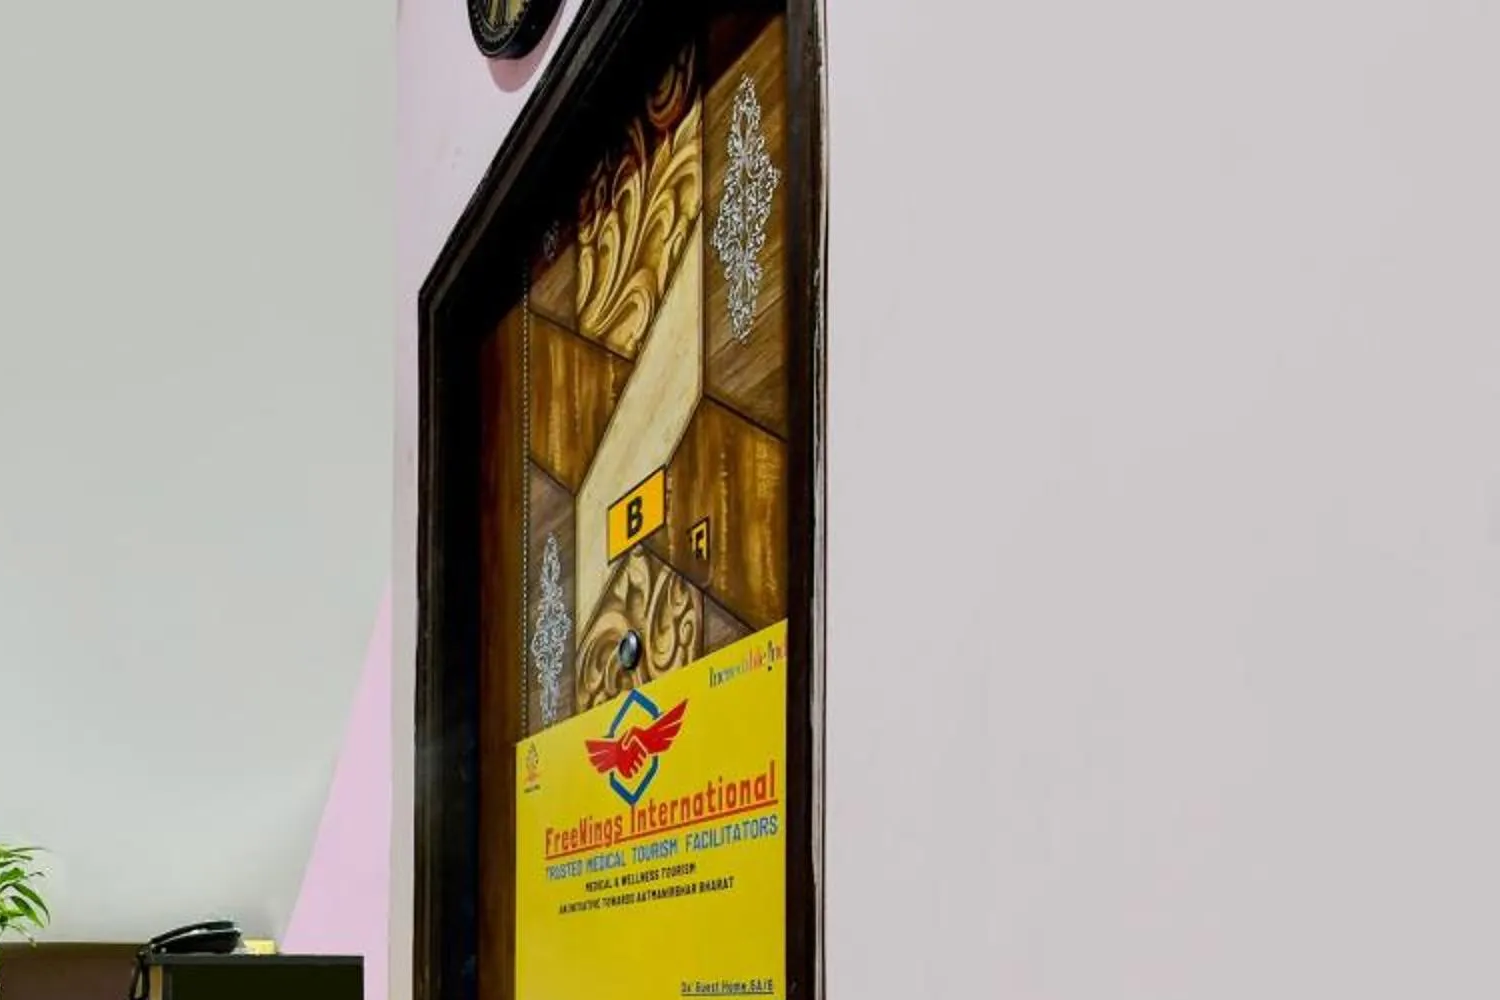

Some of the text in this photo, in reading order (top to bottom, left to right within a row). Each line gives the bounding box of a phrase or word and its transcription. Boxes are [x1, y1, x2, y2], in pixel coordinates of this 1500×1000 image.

[627, 496, 643, 540] B
[630, 760, 775, 834] International
[586, 850, 625, 873] MEDICAL
[632, 838, 678, 864] TOURISM
[686, 813, 779, 853] FACILITATORS
[585, 878, 612, 892] MEDICAL
[621, 868, 659, 886] WELLNESS
[661, 862, 697, 878] TOURISM
[700, 876, 735, 893] BHARAT
